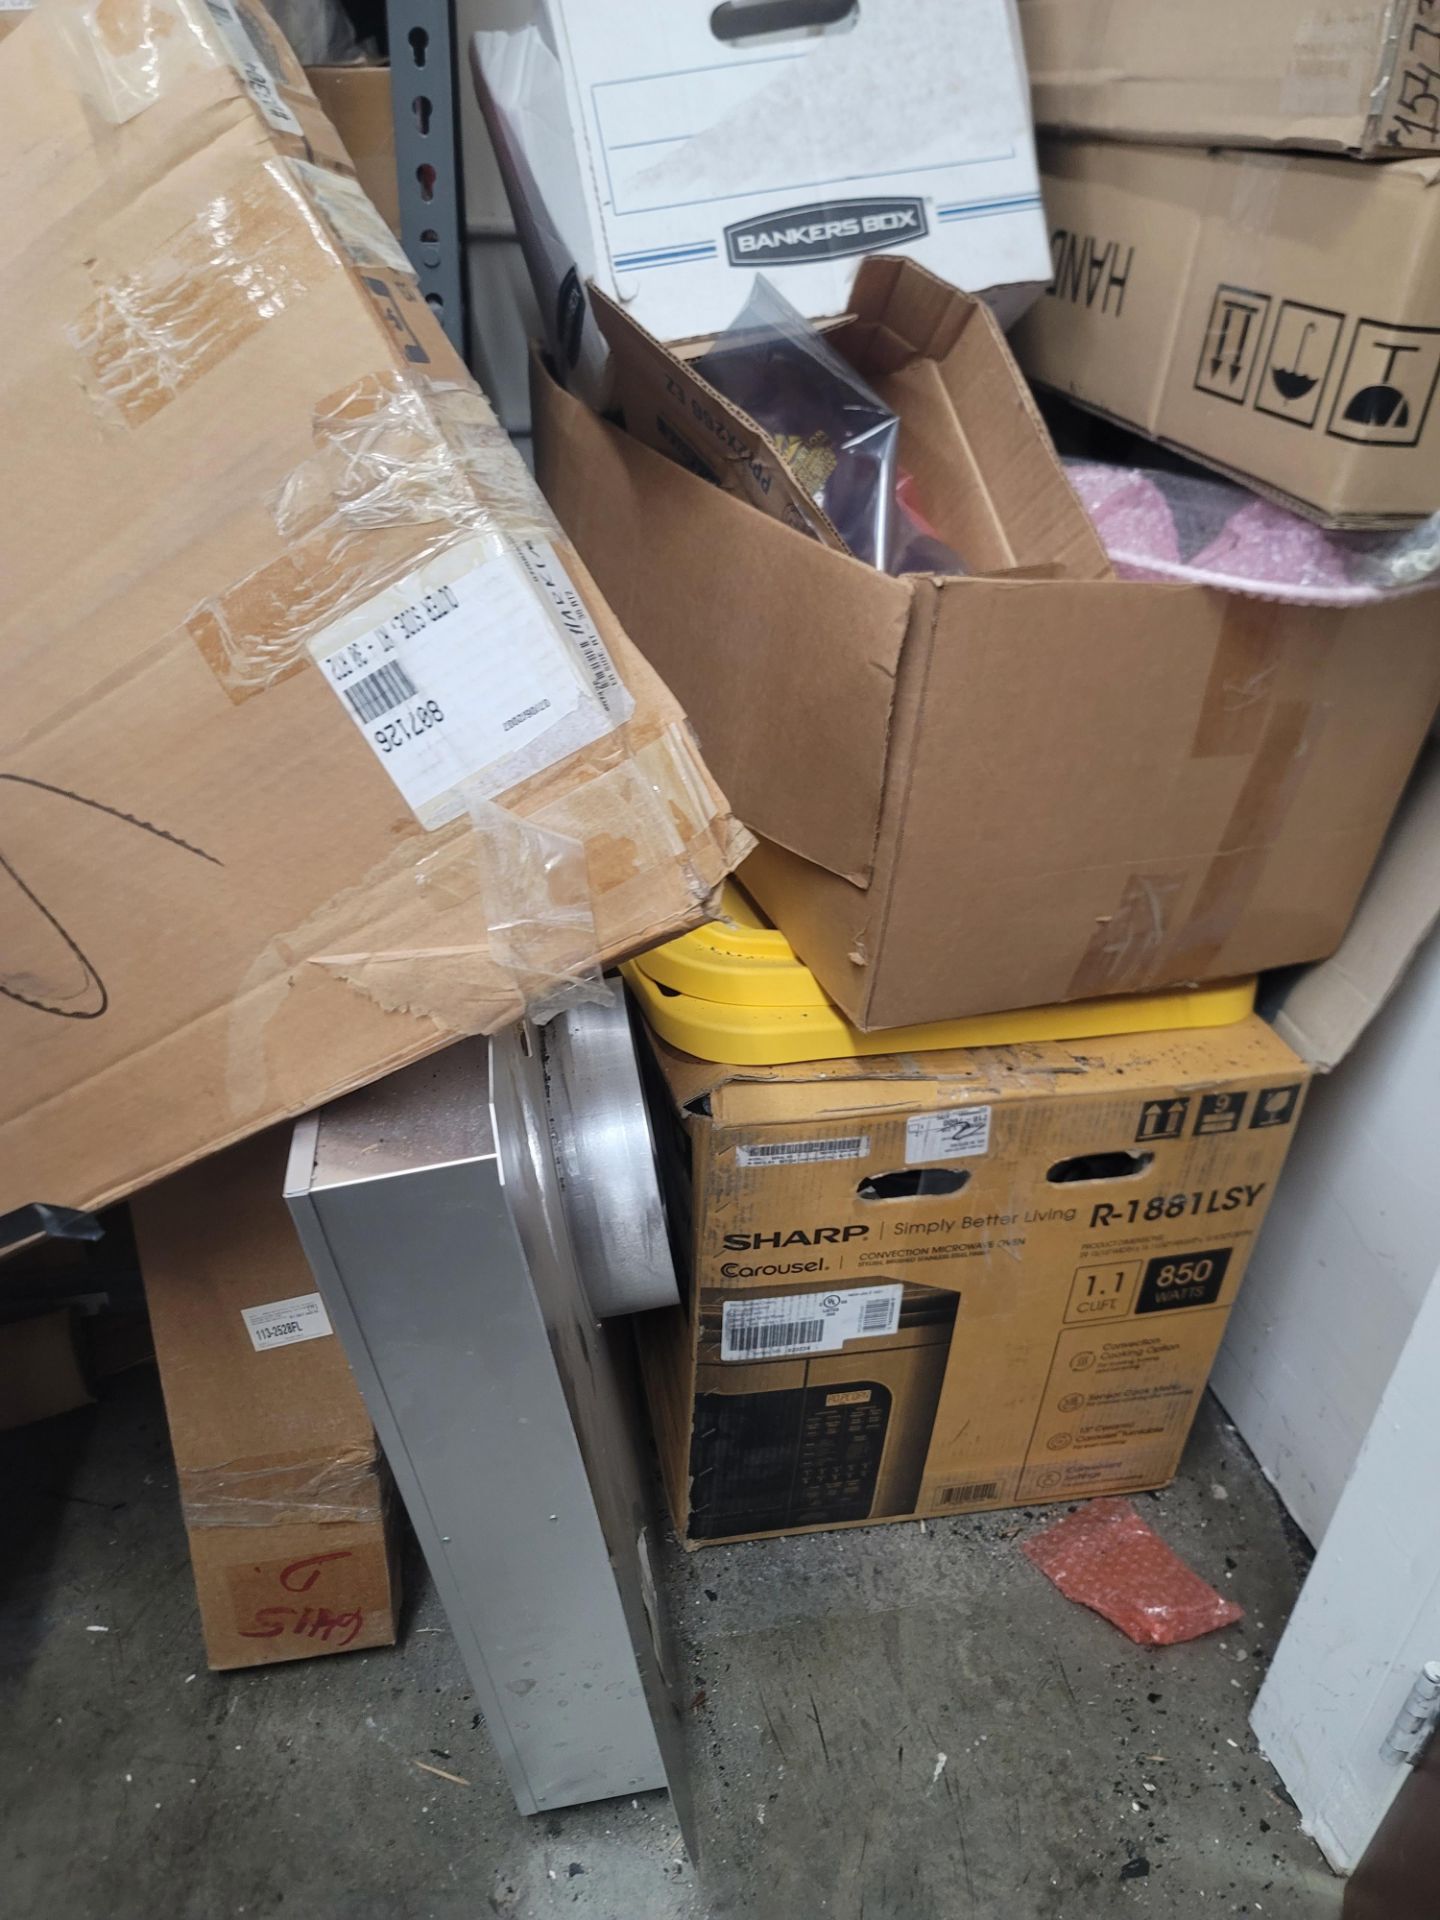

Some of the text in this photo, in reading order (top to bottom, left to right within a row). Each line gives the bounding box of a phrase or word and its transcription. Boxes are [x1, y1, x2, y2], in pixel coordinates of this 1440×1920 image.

[737, 209, 918, 253] BANKERS BOX
[374, 700, 445, 753] 807126
[1089, 1183, 1266, 1228] R-1881LSY
[894, 1208, 1077, 1236] Simply Better Living
[722, 1225, 870, 1251] SHARP
[859, 1246, 930, 1261] CONVECTION
[1086, 1271, 1125, 1297] 1.1
[1156, 1259, 1214, 1288] 850
[1155, 1286, 1205, 1304] WATTS
